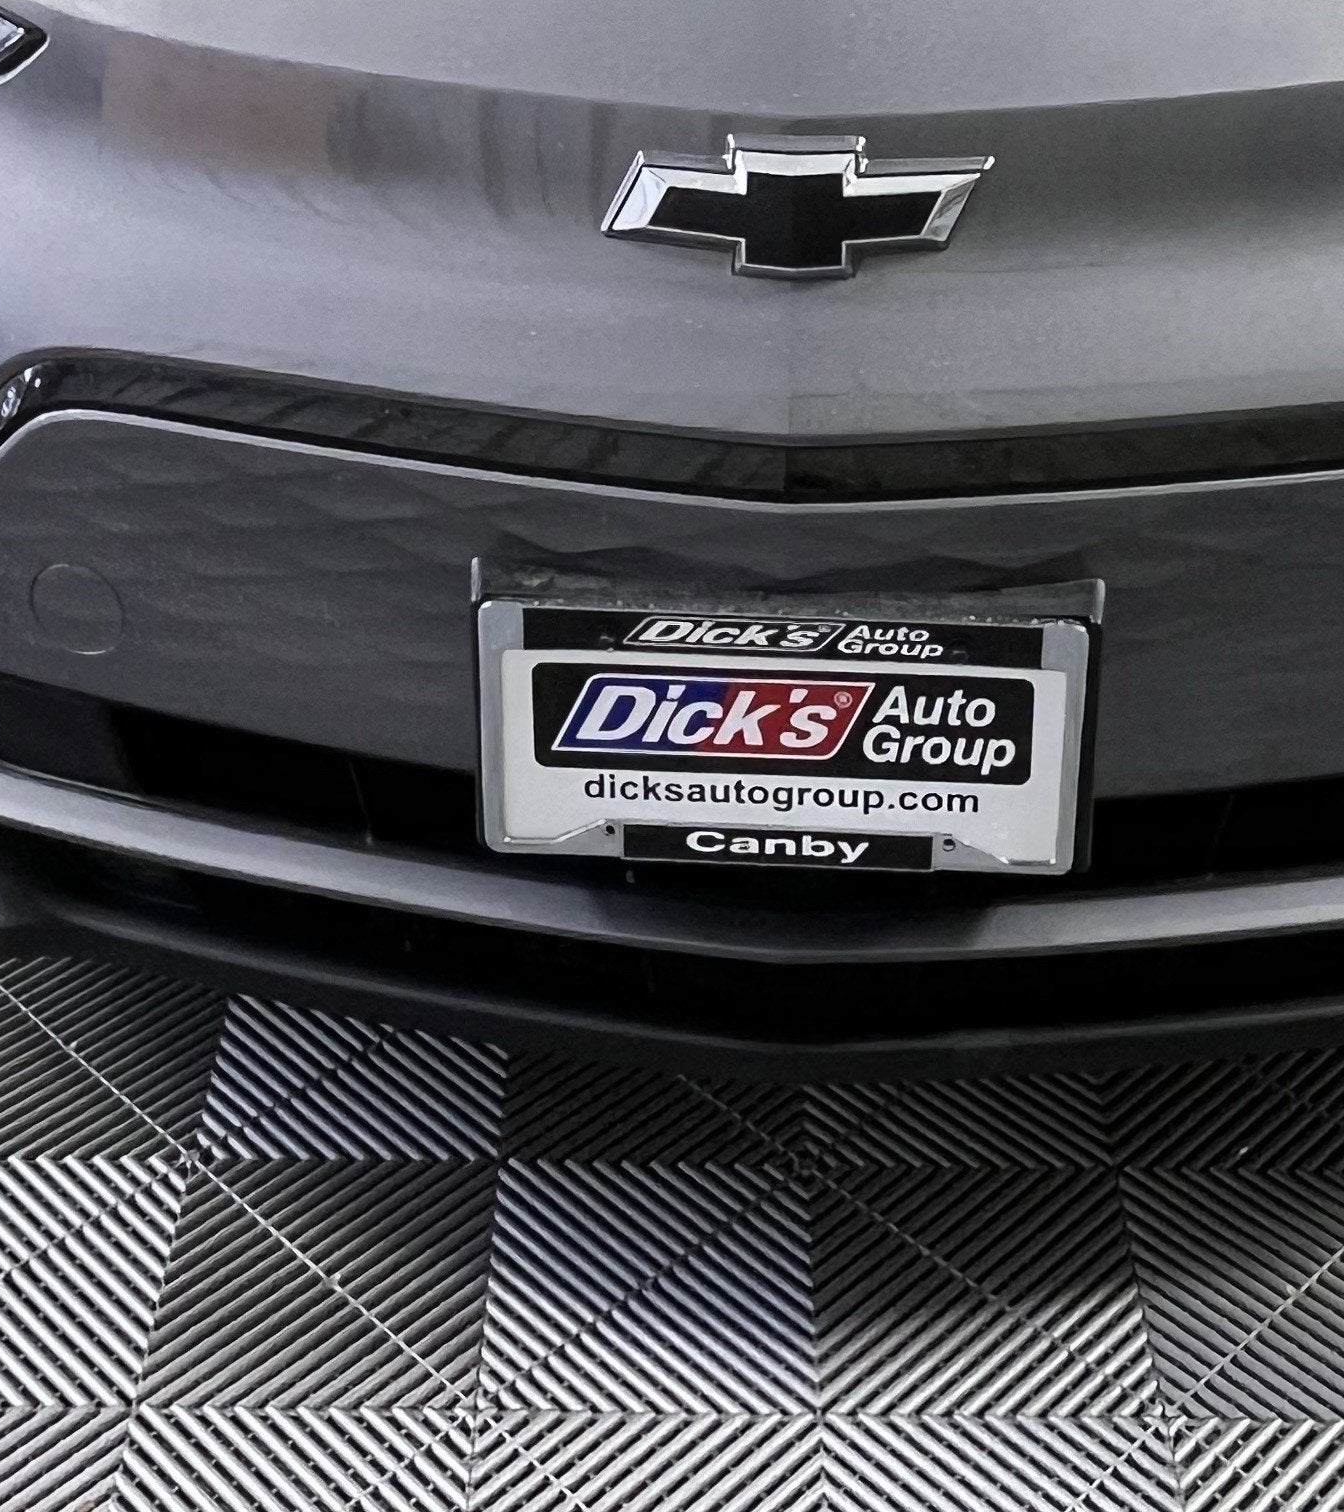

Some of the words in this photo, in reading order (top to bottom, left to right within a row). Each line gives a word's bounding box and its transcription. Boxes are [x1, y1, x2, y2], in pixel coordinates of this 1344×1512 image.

[638, 620, 820, 648] Dick's
[837, 639, 944, 660] Group
[846, 624, 930, 642] Auto
[575, 684, 838, 749] Dick's
[872, 685, 996, 728] Auto
[862, 724, 1016, 776] Group
[583, 774, 979, 815] dicksautogroup.com
[686, 830, 870, 864] Canby
